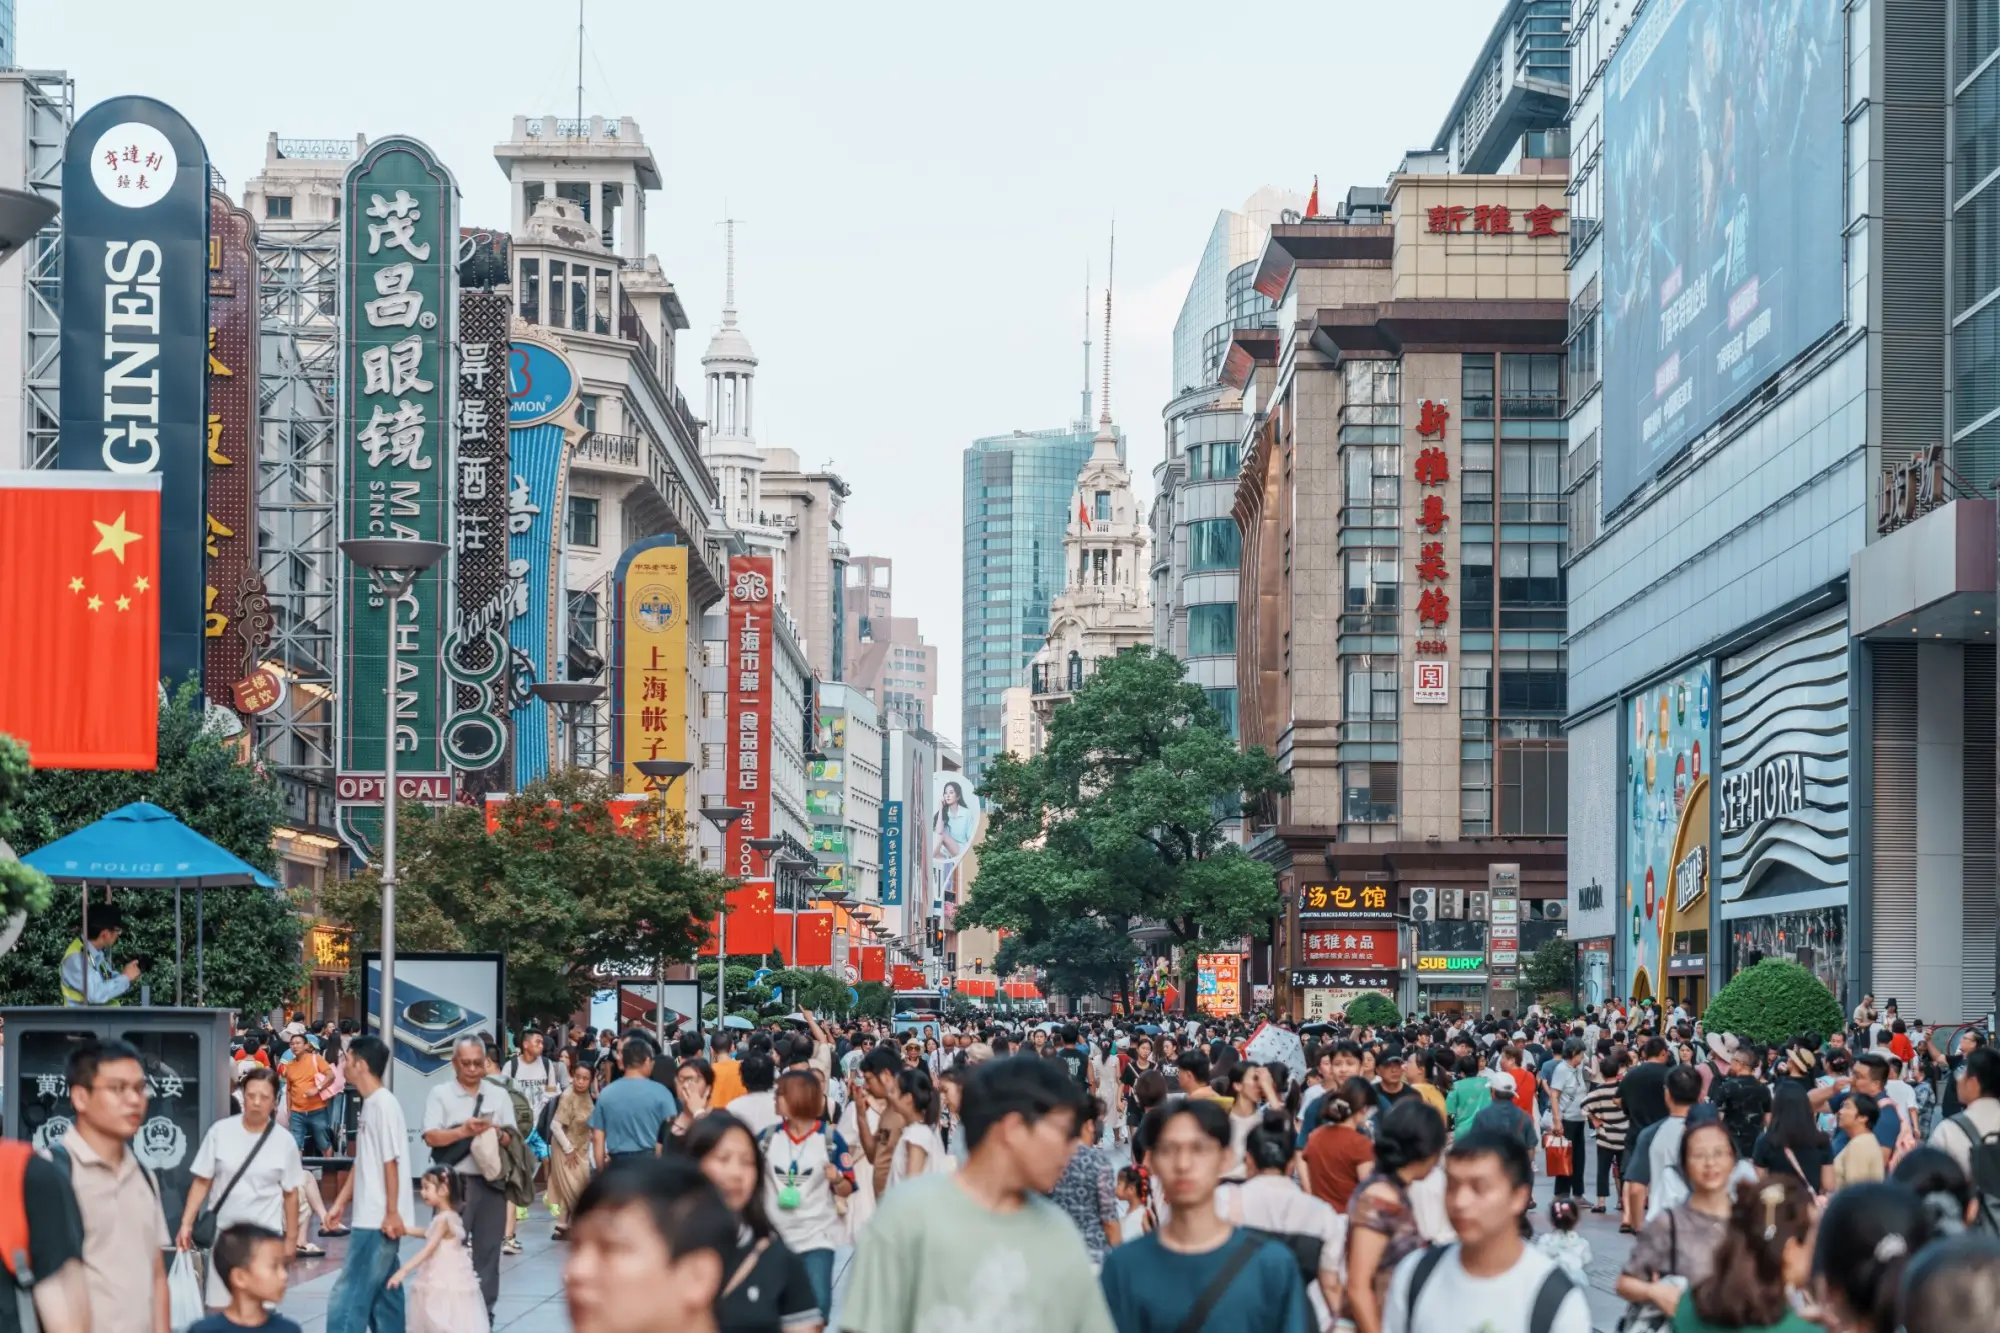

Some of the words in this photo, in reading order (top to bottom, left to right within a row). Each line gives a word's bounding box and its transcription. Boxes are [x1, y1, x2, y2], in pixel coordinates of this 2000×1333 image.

[510, 401, 547, 413] MON
[369, 480, 385, 541] SINC
[390, 481, 421, 752] MACHANG
[738, 611, 760, 790] 上海市第一食品商店
[339, 778, 448, 799] OPTCAL
[1720, 753, 1802, 833] SEPHORA
[740, 802, 755, 831] First
[90, 862, 165, 872] POLICE
[1308, 885, 1387, 908] 汤包馆
[1309, 934, 1374, 950] 新雅食品
[1418, 956, 1484, 970] SUBWAY
[36, 1074, 70, 1098] 黄
